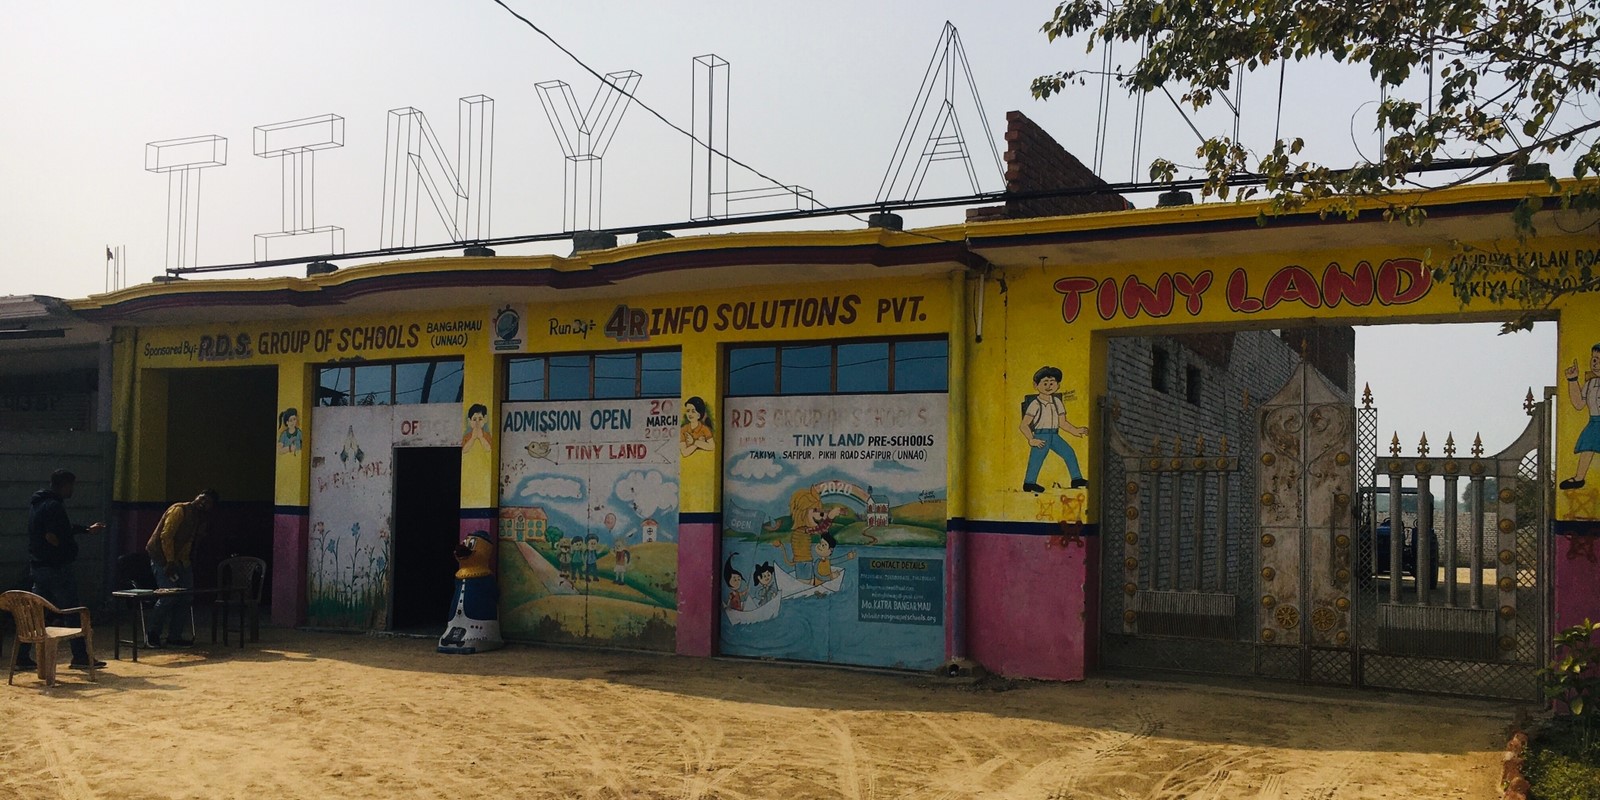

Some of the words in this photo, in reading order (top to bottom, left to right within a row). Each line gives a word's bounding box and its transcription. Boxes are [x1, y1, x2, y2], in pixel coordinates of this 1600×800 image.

[1053, 270, 1213, 324] TINY
[1226, 258, 1432, 313] LAND
[549, 317, 571, 335] Run
[604, 303, 651, 341] 4R
[650, 304, 708, 336] INFO
[713, 294, 861, 331] SOLUTIONS
[876, 296, 927, 323] PVT.
[427, 320, 482, 333] BANGARMAU
[144, 341, 183, 359] Sponsored
[258, 330, 310, 354] GROUP
[314, 328, 335, 352] OF
[337, 324, 420, 352] SCHOOLS
[430, 333, 468, 348] (UNNAO)
[503, 410, 581, 432] ADMISSION
[590, 408, 632, 430] OPEN
[646, 415, 678, 427] MARCH
[793, 433, 824, 447] TINY
[829, 433, 865, 447] LAND
[868, 434, 934, 447] PRE-SCHOOLS
[565, 444, 604, 460] TINY
[609, 443, 648, 460] LAND
[818, 450, 837, 459] PIKHI
[840, 450, 859, 459] ROAD
[860, 450, 891, 460] SAFIPUR
[892, 449, 928, 462] (UNNAO)
[820, 481, 852, 496] 2020
[731, 518, 752, 529] OPEN
[871, 560, 900, 569] CONTACT
[901, 561, 926, 569] DETAILS
[893, 600, 931, 611] BANGARMAU
